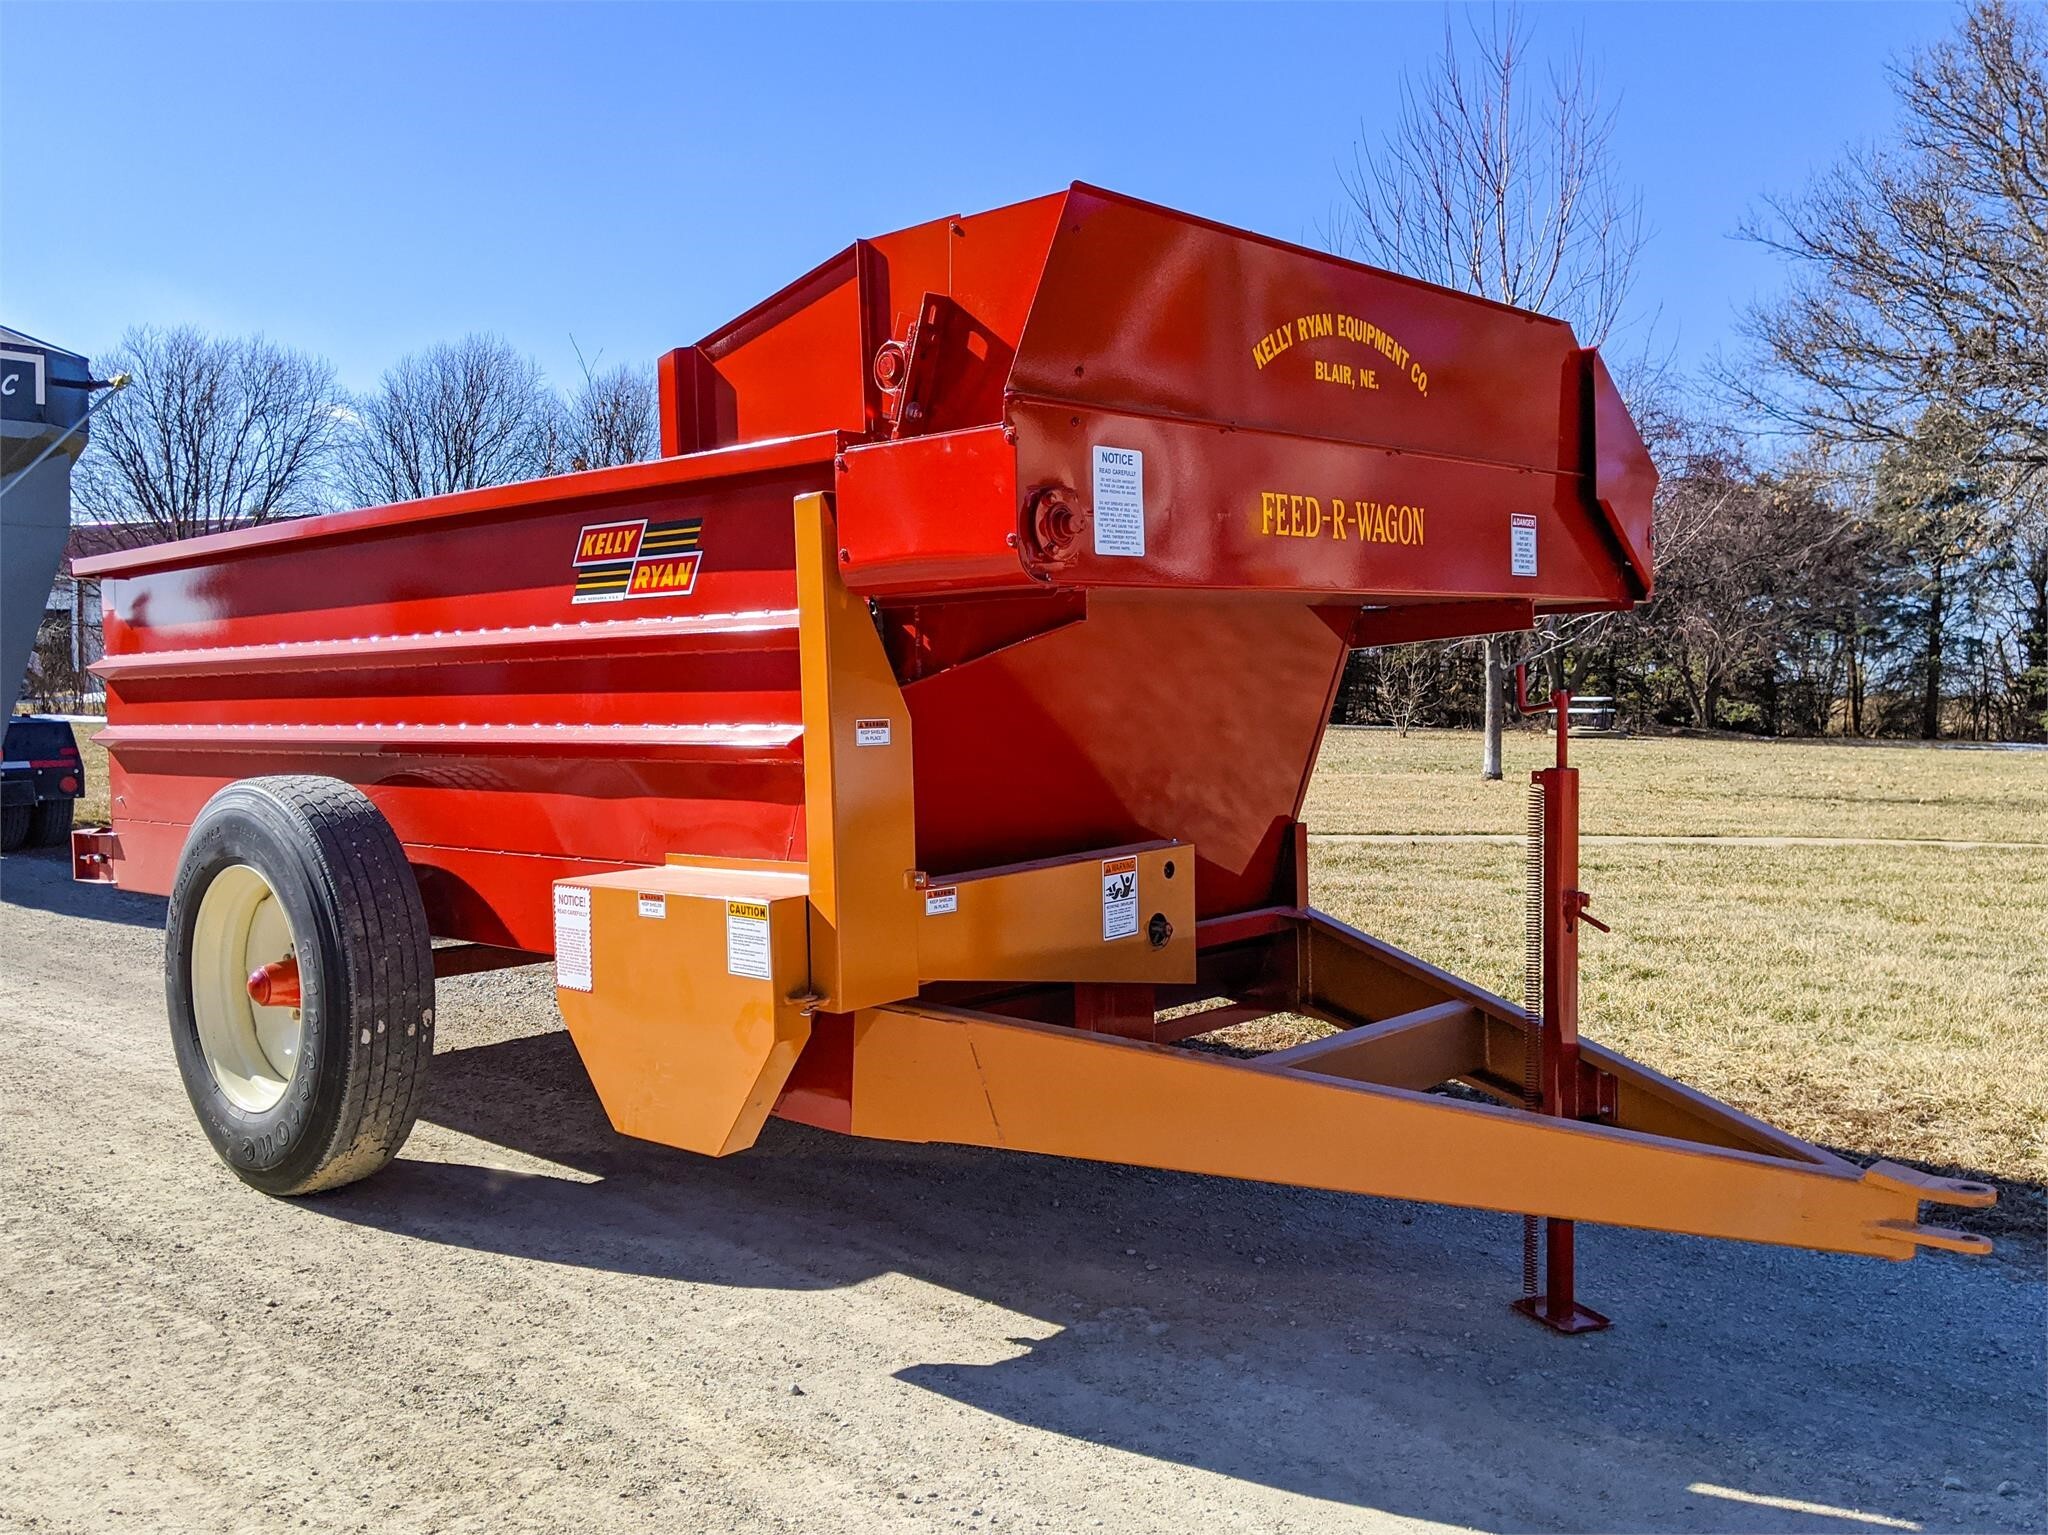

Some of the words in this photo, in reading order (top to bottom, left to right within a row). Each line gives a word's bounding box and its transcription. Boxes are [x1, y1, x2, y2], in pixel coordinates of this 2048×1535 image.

[1252, 322, 1292, 370] KELLY
[1297, 313, 1333, 341] RYAN
[1337, 313, 1410, 371] EQUIPMENT
[1410, 362, 1428, 398] CO.
[1314, 360, 1355, 390] BLAIR,
[1359, 368, 1379, 390] NE.
[1101, 451, 1134, 466] NOTICE
[1112, 468, 1136, 477] CAREFULLY
[1261, 492, 1425, 546] FEED-R-WAGON
[581, 529, 638, 557] KELLY
[633, 561, 693, 589] RYAN
[558, 894, 586, 908] NOTICE!
[729, 904, 766, 918] CAUTION
